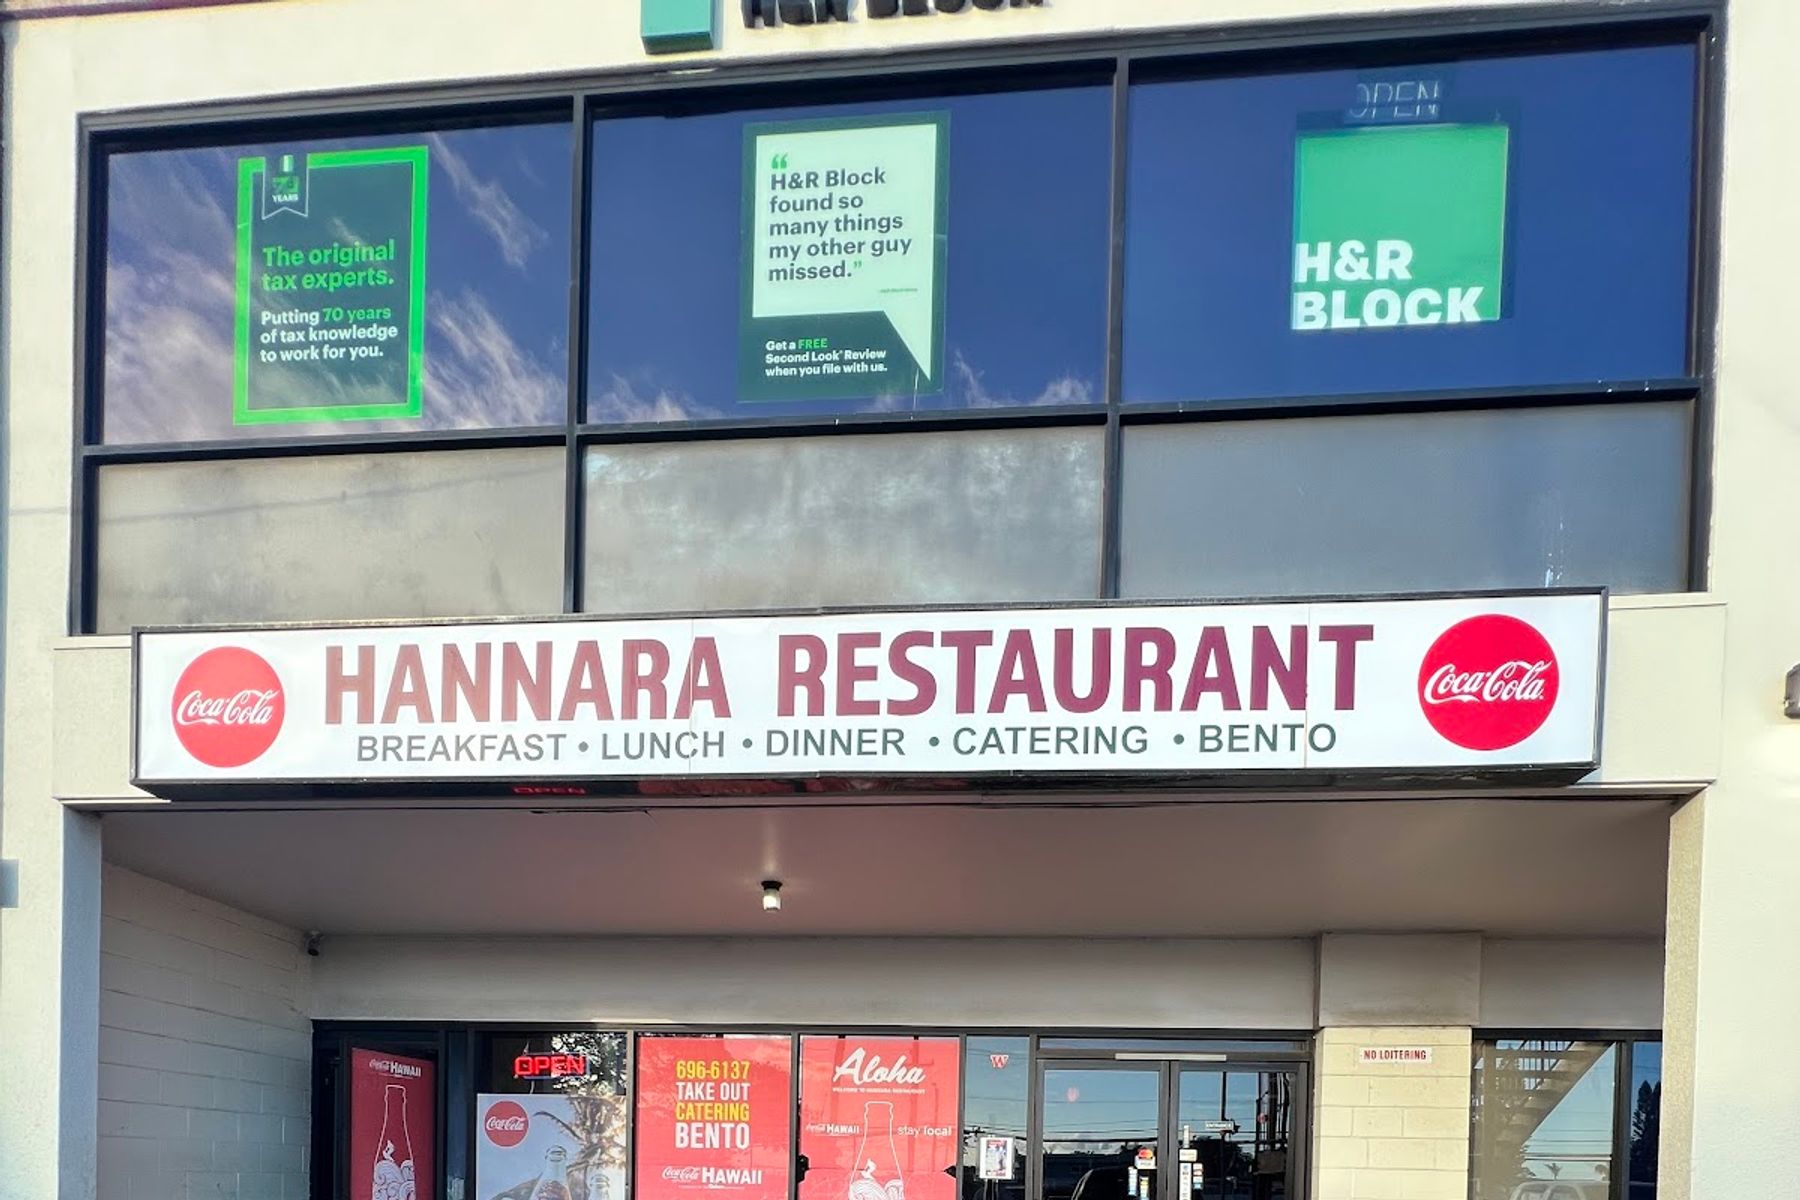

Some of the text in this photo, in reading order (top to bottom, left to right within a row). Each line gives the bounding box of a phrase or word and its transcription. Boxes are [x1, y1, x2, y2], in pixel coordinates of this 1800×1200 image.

[1349, 80, 1441, 120] OPEN
[770, 166, 886, 190] H&R Block
[770, 192, 863, 213] found so
[769, 213, 903, 237] many things
[263, 239, 395, 267] The original
[769, 237, 912, 261] my other guy
[1294, 239, 1414, 283] H&R
[262, 267, 394, 292] tax experts.
[261, 308, 391, 326] Putting 70 years
[1291, 286, 1485, 330] BLOCK
[260, 323, 398, 343] of tax knowledge
[260, 344, 384, 363] to work for you.
[766, 338, 828, 351] Get a FREE
[765, 351, 809, 364] Second
[844, 349, 886, 361] Review
[765, 361, 888, 378] when you file with us.
[324, 624, 1374, 725] HANNARA RESTAURANT
[1424, 659, 1552, 704] Coca-Cola
[177, 689, 280, 725] Coca-Cola
[356, 722, 1336, 762] BREAKFAST LUNCH DINNER CATERING BENTO
[1364, 1050, 1426, 1060] NO LOITERING
[390, 1061, 421, 1077] HAWAII
[515, 1056, 585, 1075] OPEN
[676, 1060, 750, 1079] 696-6137
[833, 1047, 926, 1085] Aloha
[676, 1082, 751, 1101] TAKE OUT
[676, 1102, 750, 1121] CATERING
[486, 1116, 527, 1131] Coca-Cola
[827, 1124, 860, 1134] HAWAII
[897, 1125, 952, 1137] stay local
[675, 1122, 750, 1149] BENTO
[702, 1167, 762, 1184] HAWAII
